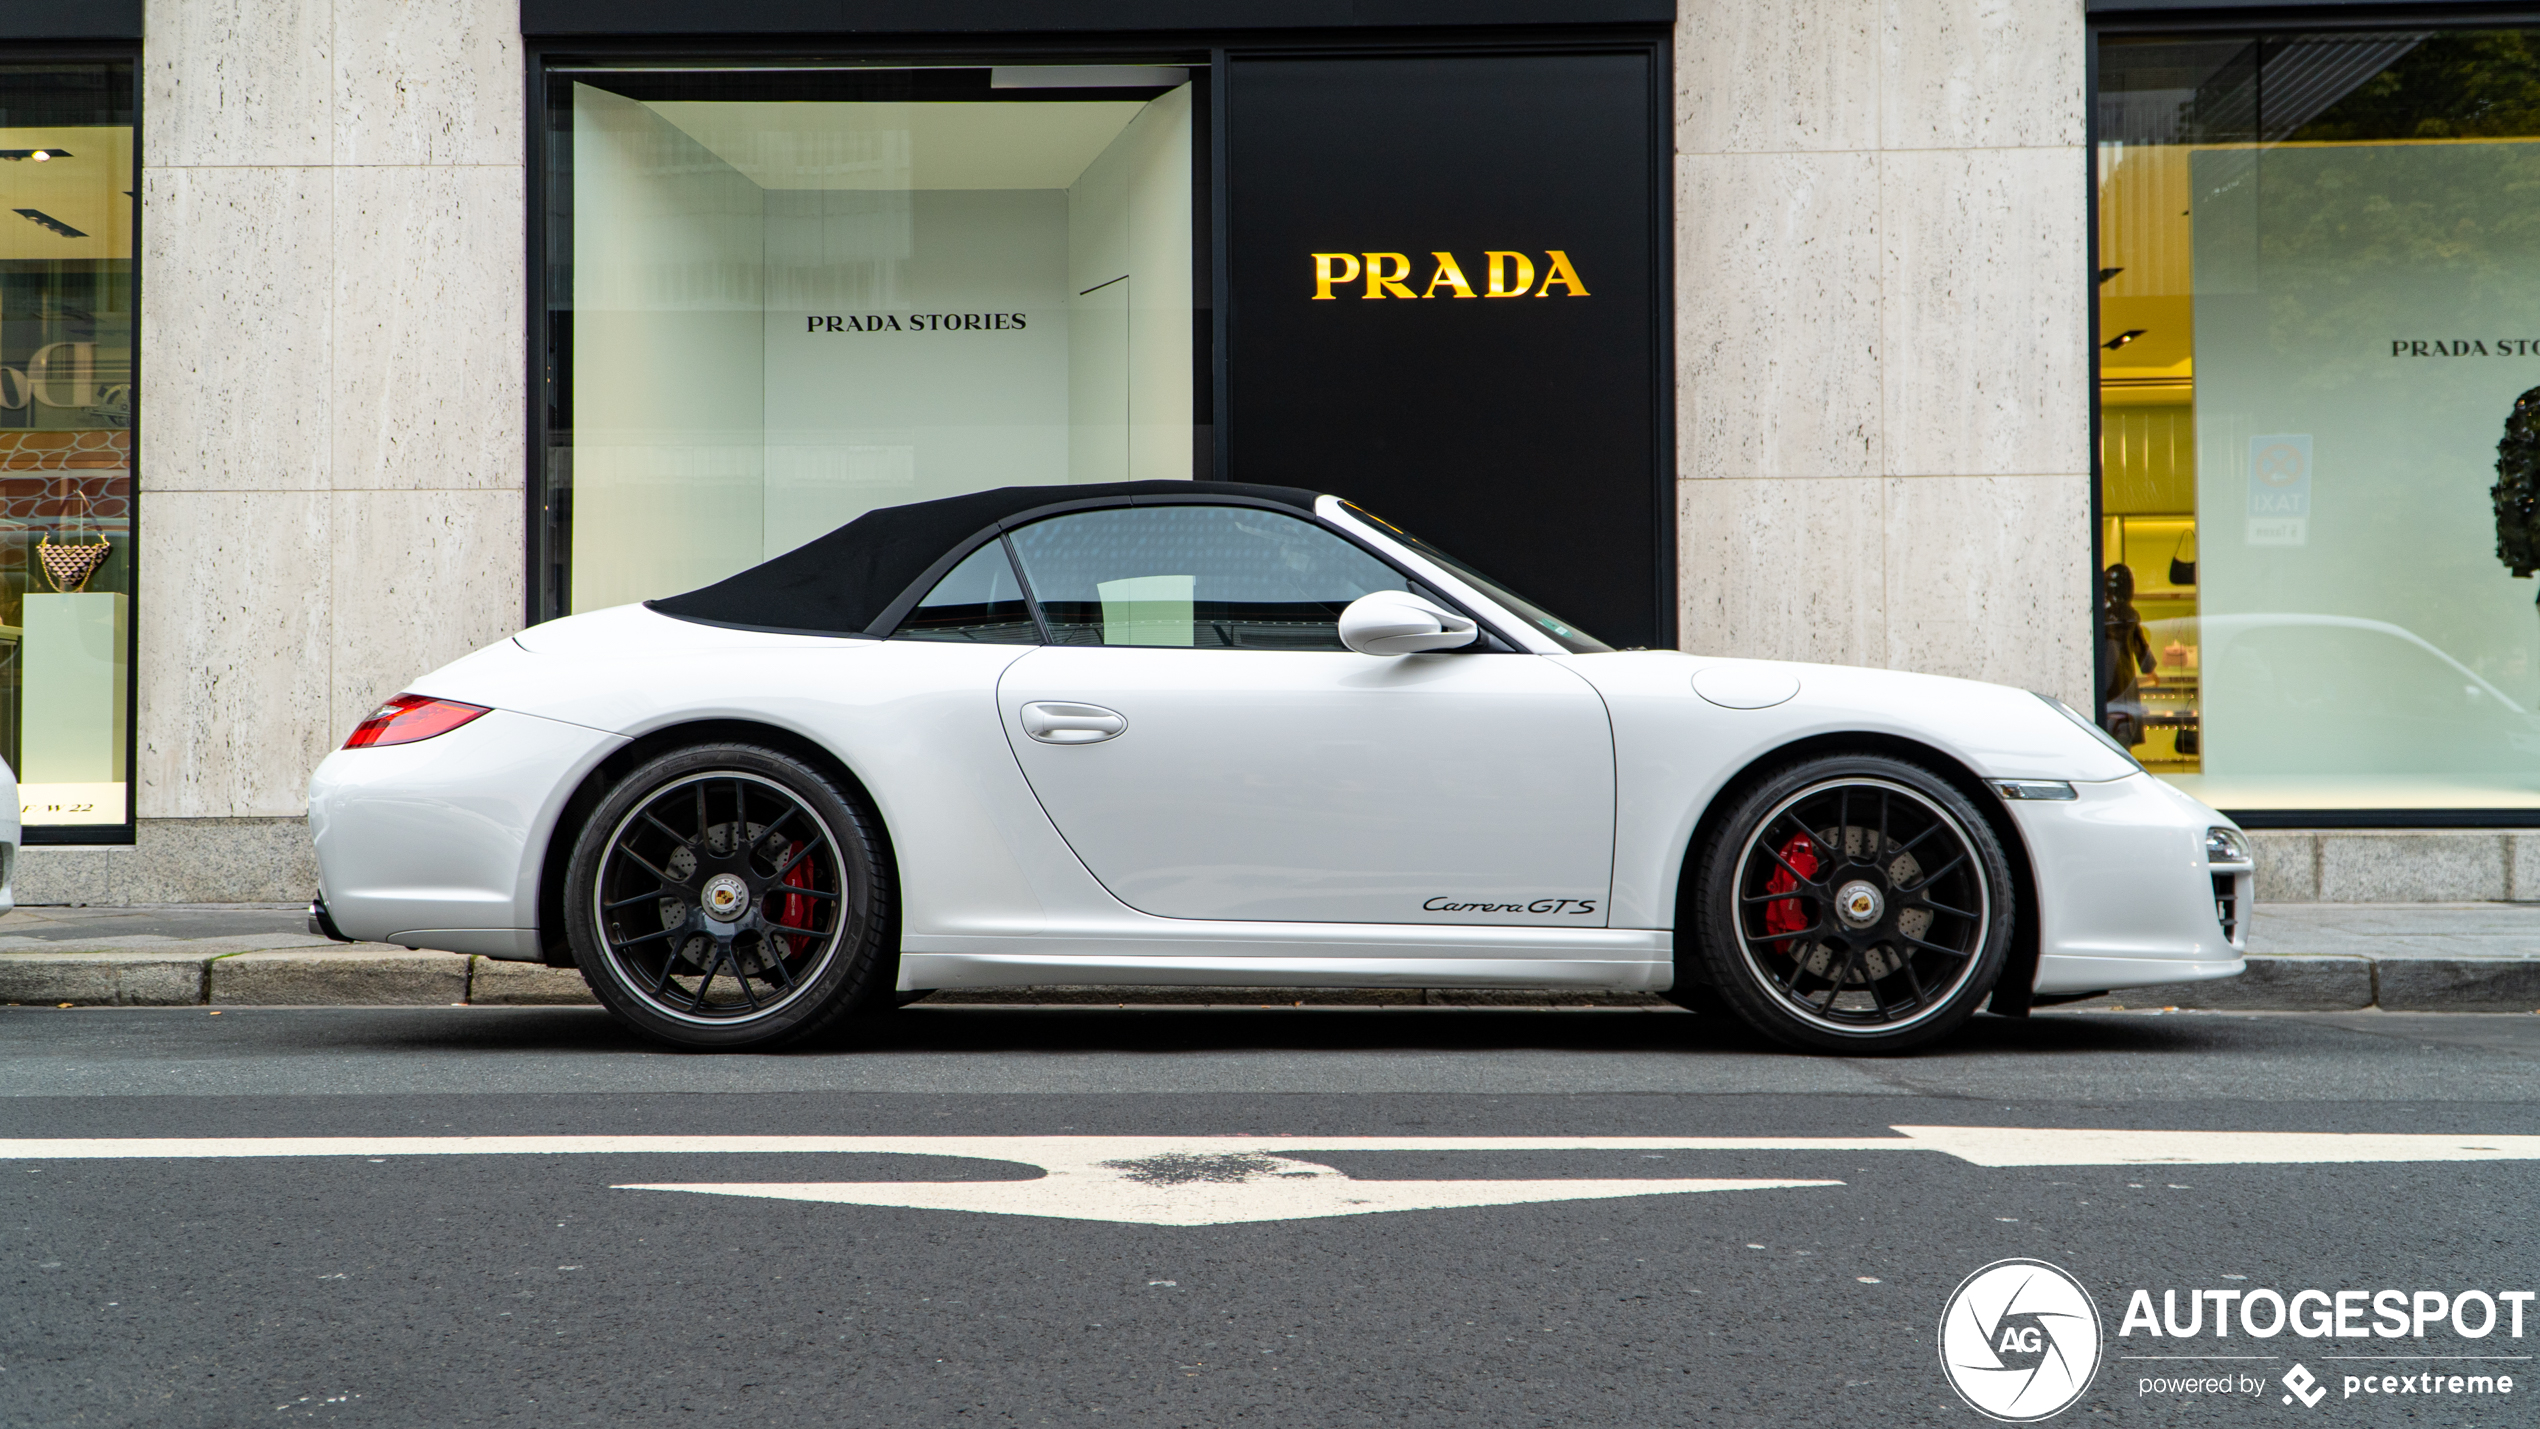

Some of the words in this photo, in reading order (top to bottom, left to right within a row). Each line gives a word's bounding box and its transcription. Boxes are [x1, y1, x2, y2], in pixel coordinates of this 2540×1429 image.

[1311, 250, 1591, 300] PRADA
[807, 315, 902, 332] PRADA
[909, 313, 1027, 331] STORIES
[2392, 340, 2489, 357] PRADA
[68, 803, 94, 813] 22
[1422, 896, 1524, 913] Carrera
[1527, 898, 1597, 915] GTS
